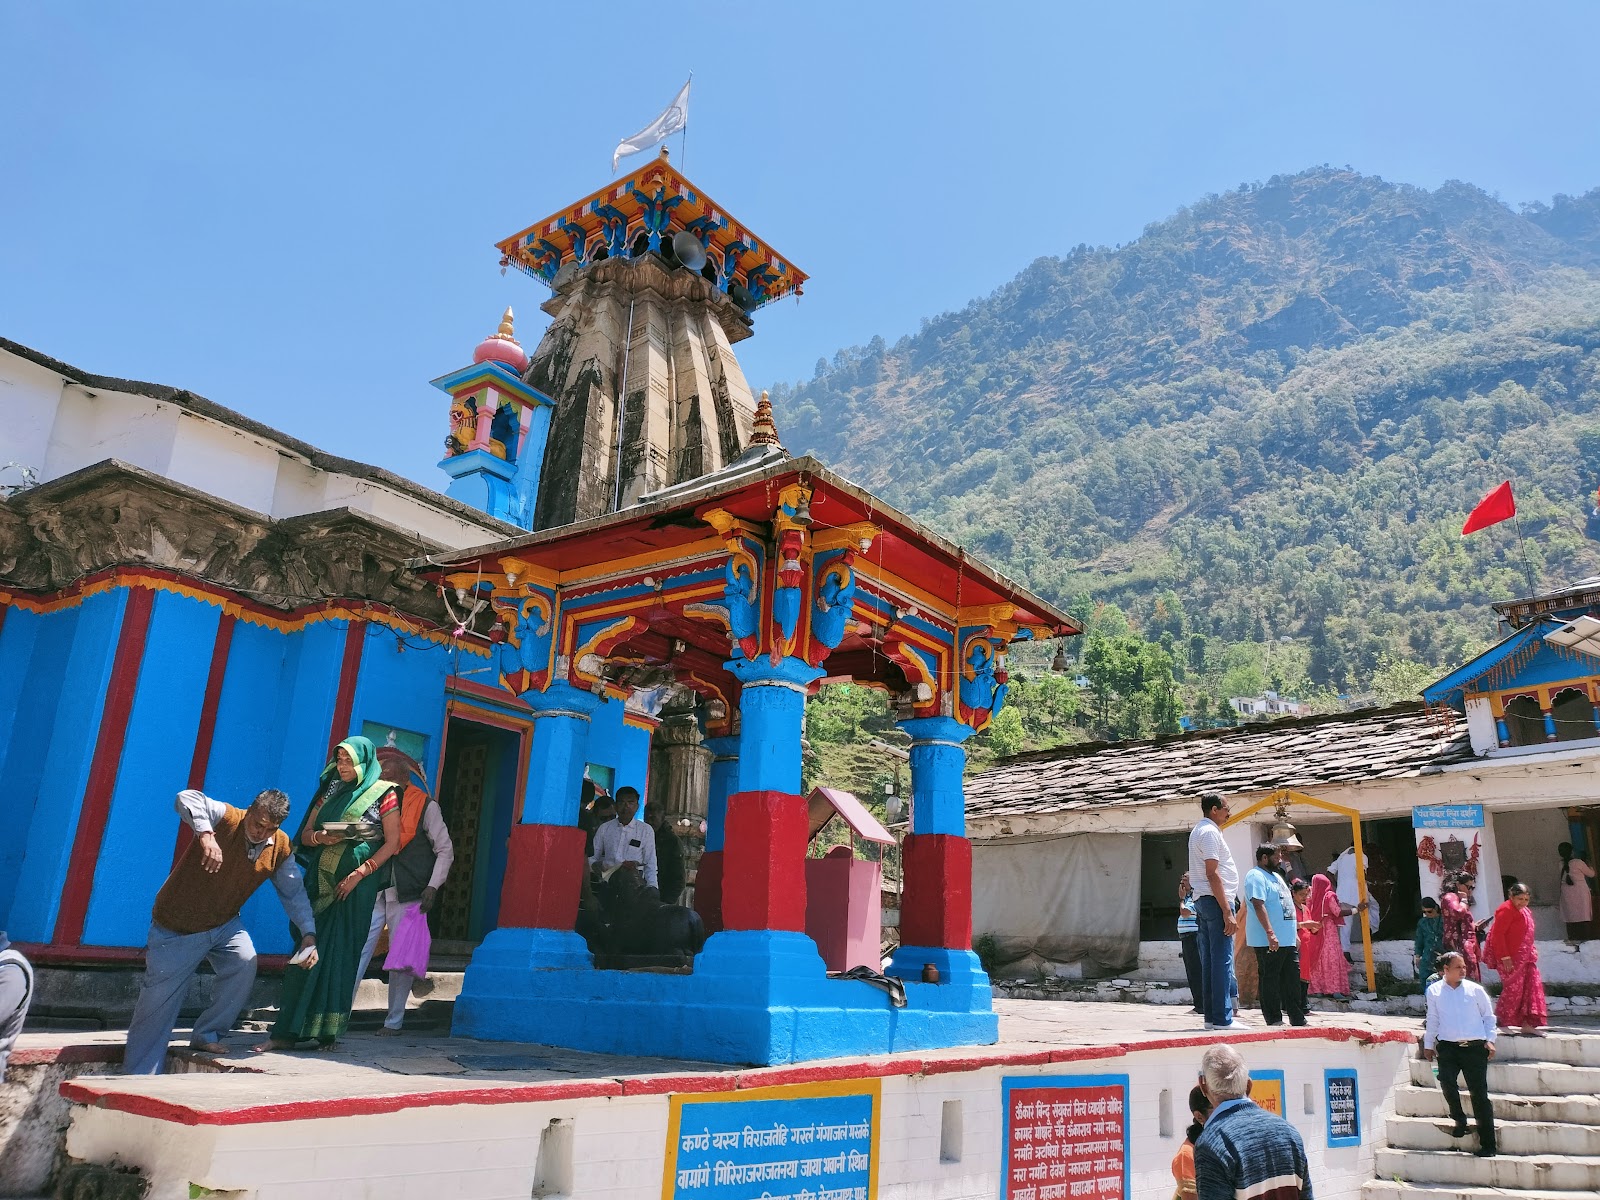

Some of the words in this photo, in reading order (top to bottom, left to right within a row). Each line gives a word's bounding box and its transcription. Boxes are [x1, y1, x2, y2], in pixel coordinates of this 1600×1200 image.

[682, 1127, 710, 1152] कण्ठे
[712, 1132, 741, 1150] यस्य
[742, 1122, 789, 1148] विराजतेहि
[790, 1122, 815, 1145] गरलं
[816, 1121, 848, 1142] गंगाजलं
[849, 1118, 870, 1140] मस्तके
[1093, 1117, 1105, 1135] नमो
[1061, 1139, 1073, 1158] देवा
[678, 1160, 710, 1190] वामांगे
[713, 1160, 799, 1186] गिरिराजराजतनया
[800, 1157, 822, 1178] जाया
[823, 1151, 846, 1175] भवानी
[847, 1149, 869, 1172] स्थिता
[1013, 1168, 1027, 1182] नरा
[1094, 1155, 1106, 1173] नमो
